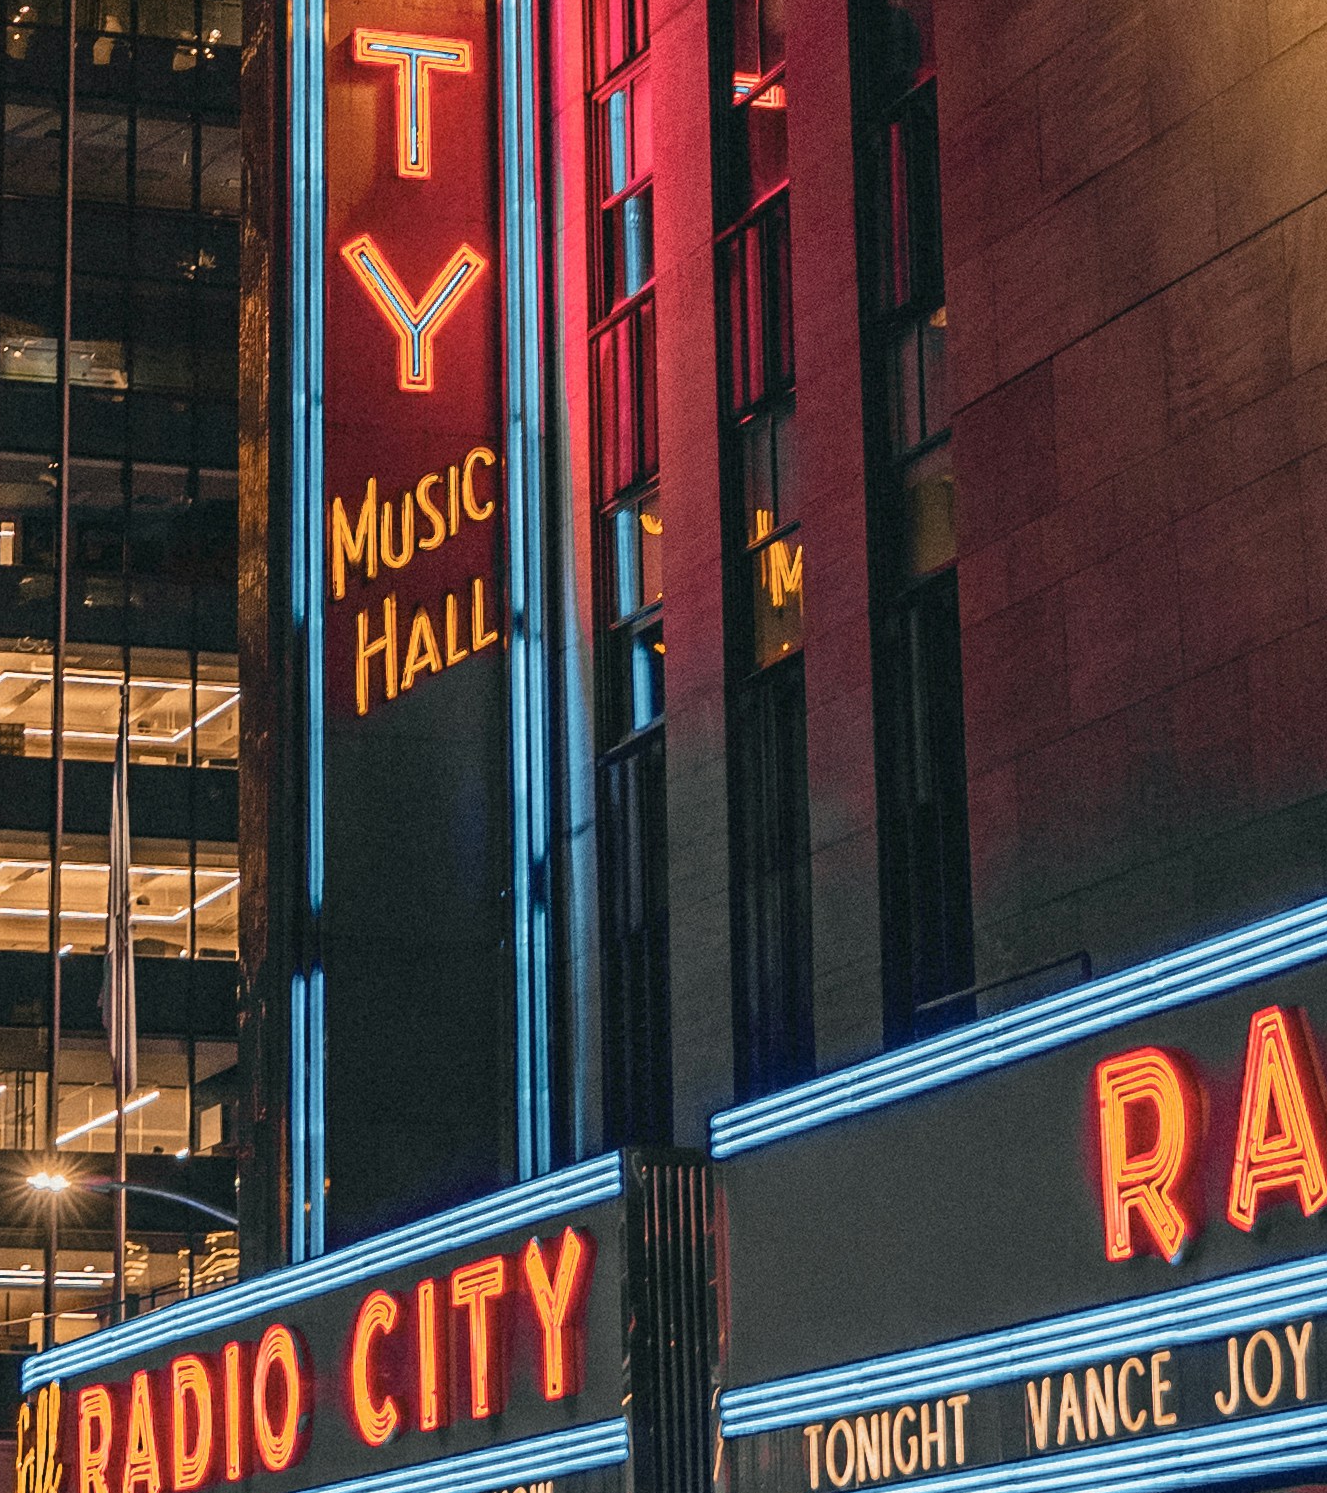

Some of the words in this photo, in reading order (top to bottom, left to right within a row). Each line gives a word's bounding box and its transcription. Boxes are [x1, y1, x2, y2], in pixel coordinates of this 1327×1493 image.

[329, 446, 497, 602] MUSIC
[355, 578, 500, 717] HALL
[349, 1225, 583, 1448] CITY
[802, 1394, 970, 1490] TONIGHT
[1026, 1349, 1177, 1452] VANCE
[1213, 1320, 1314, 1417] JOY
